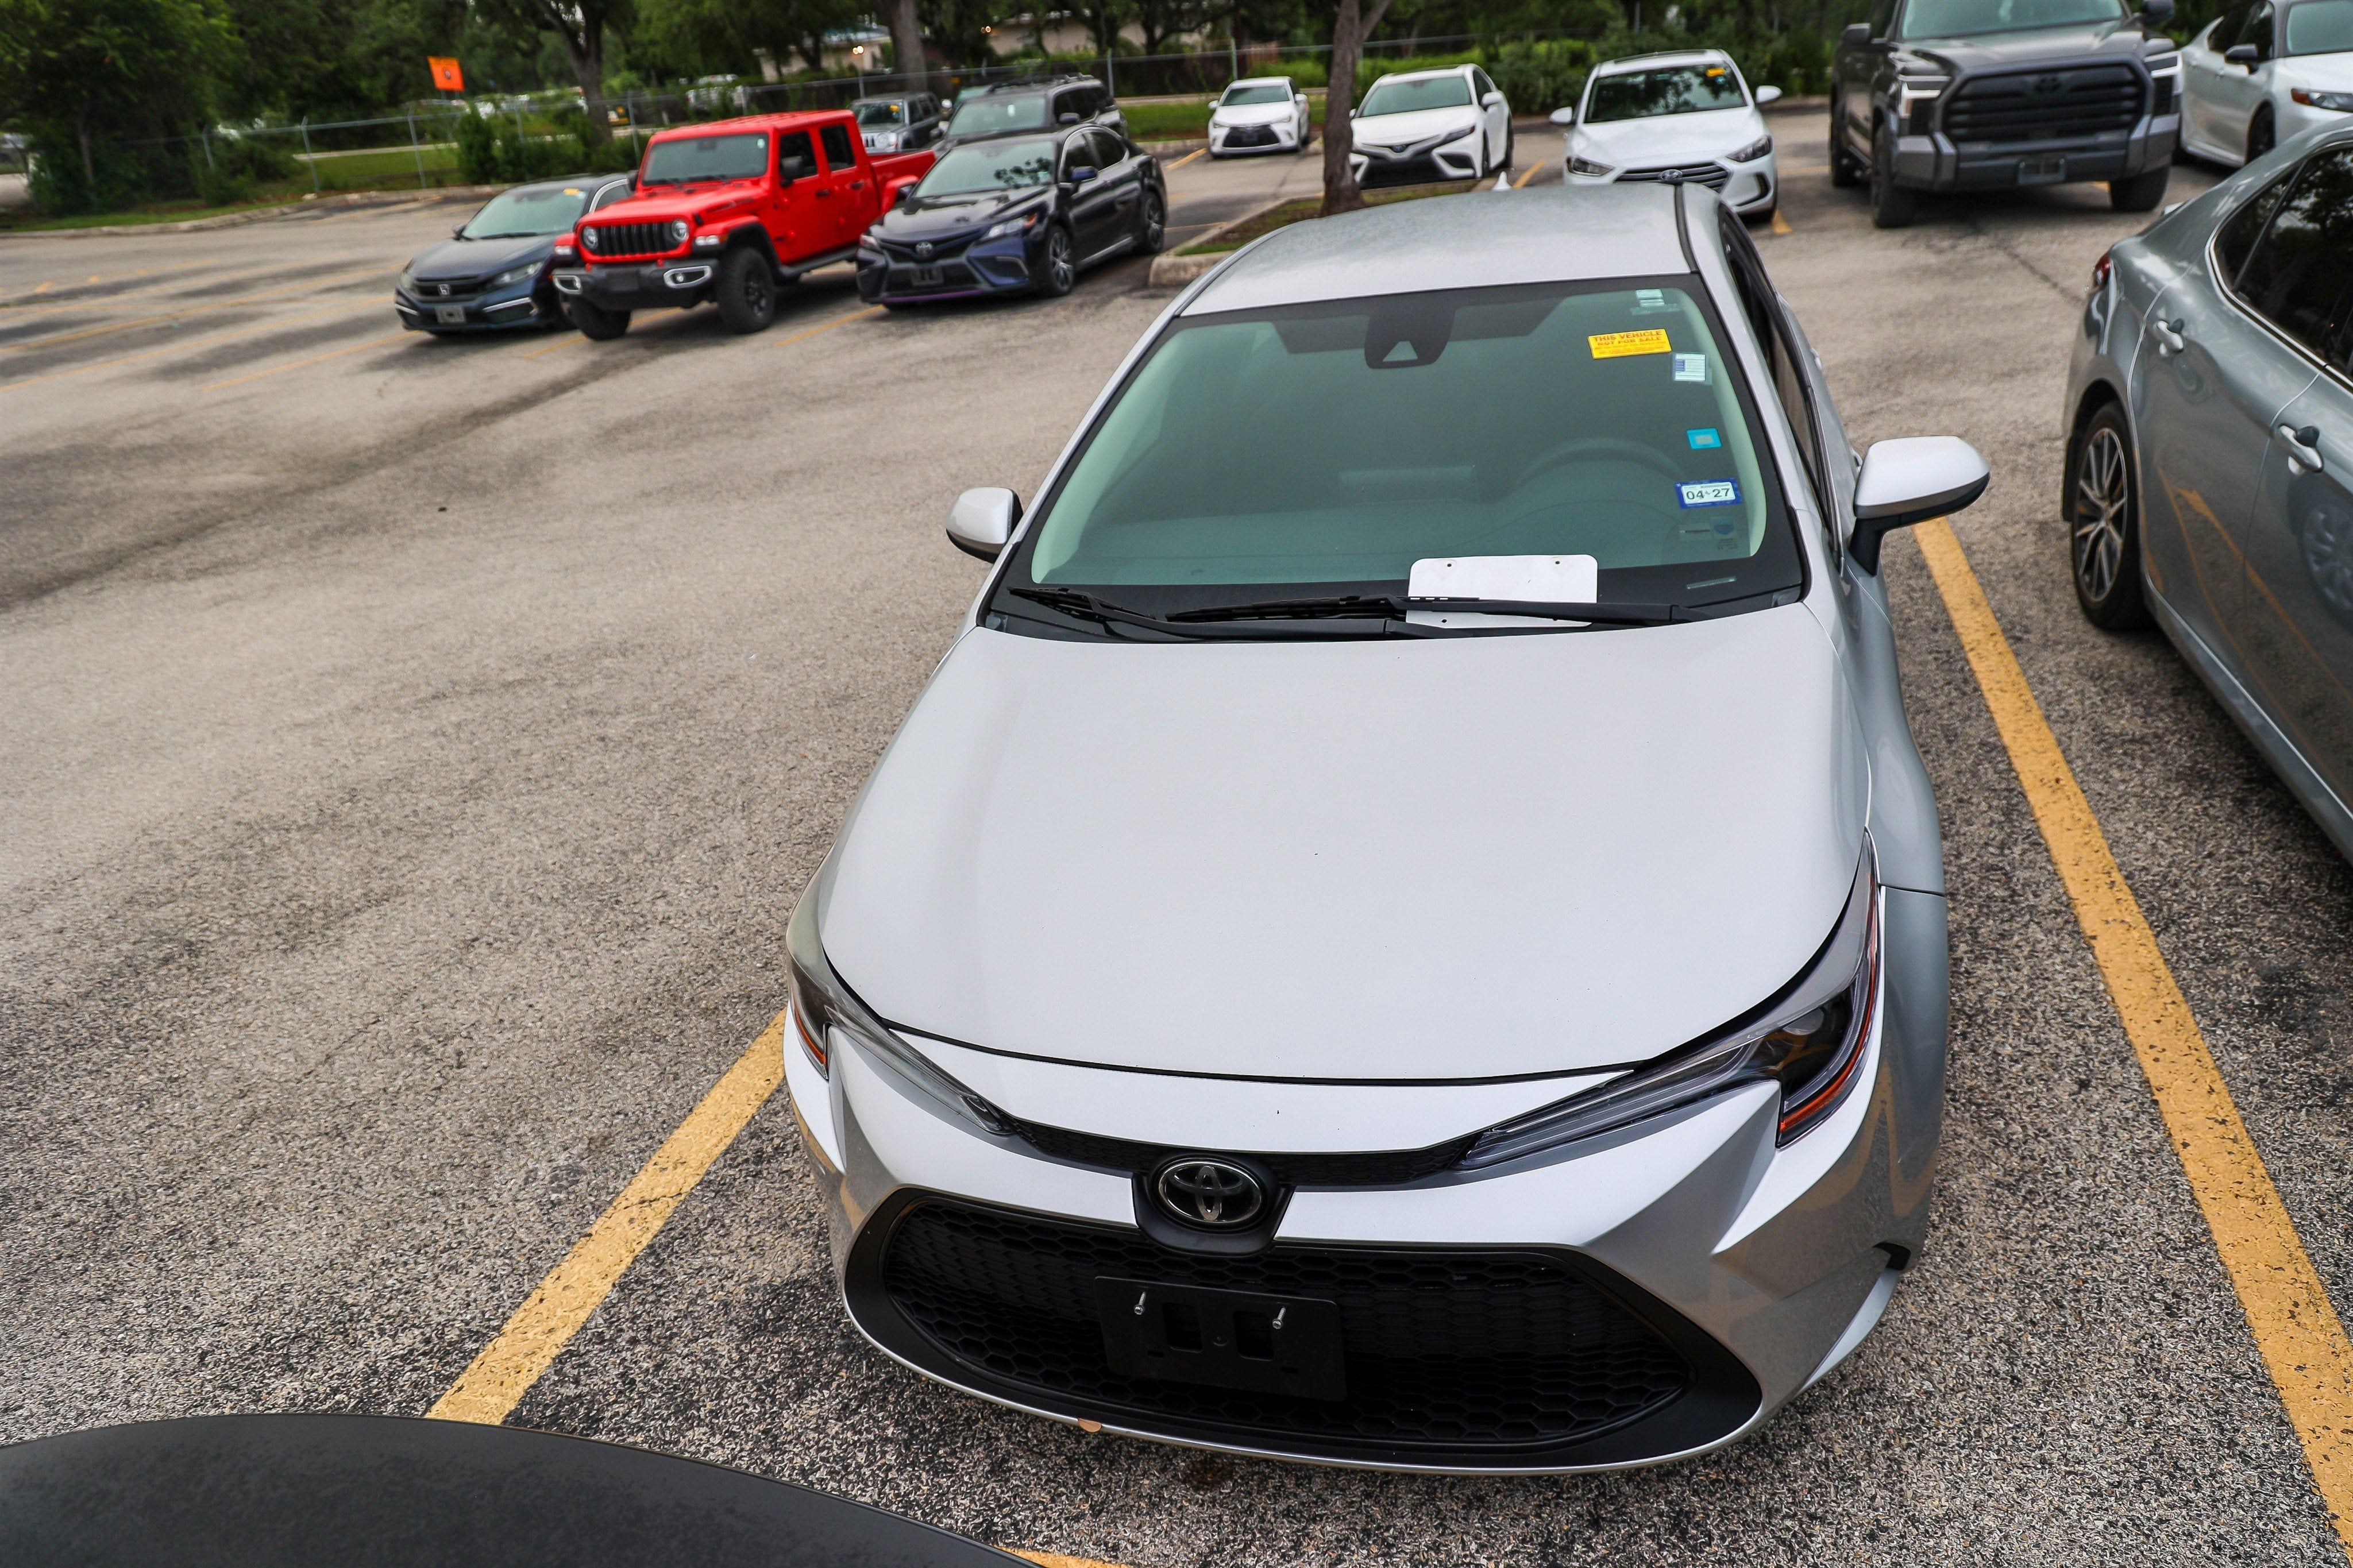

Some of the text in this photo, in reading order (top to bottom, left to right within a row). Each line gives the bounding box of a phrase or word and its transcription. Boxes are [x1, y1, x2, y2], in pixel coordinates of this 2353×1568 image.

[1618, 330, 1662, 339] VEHICLE
[1686, 488, 1730, 500] 04 27
